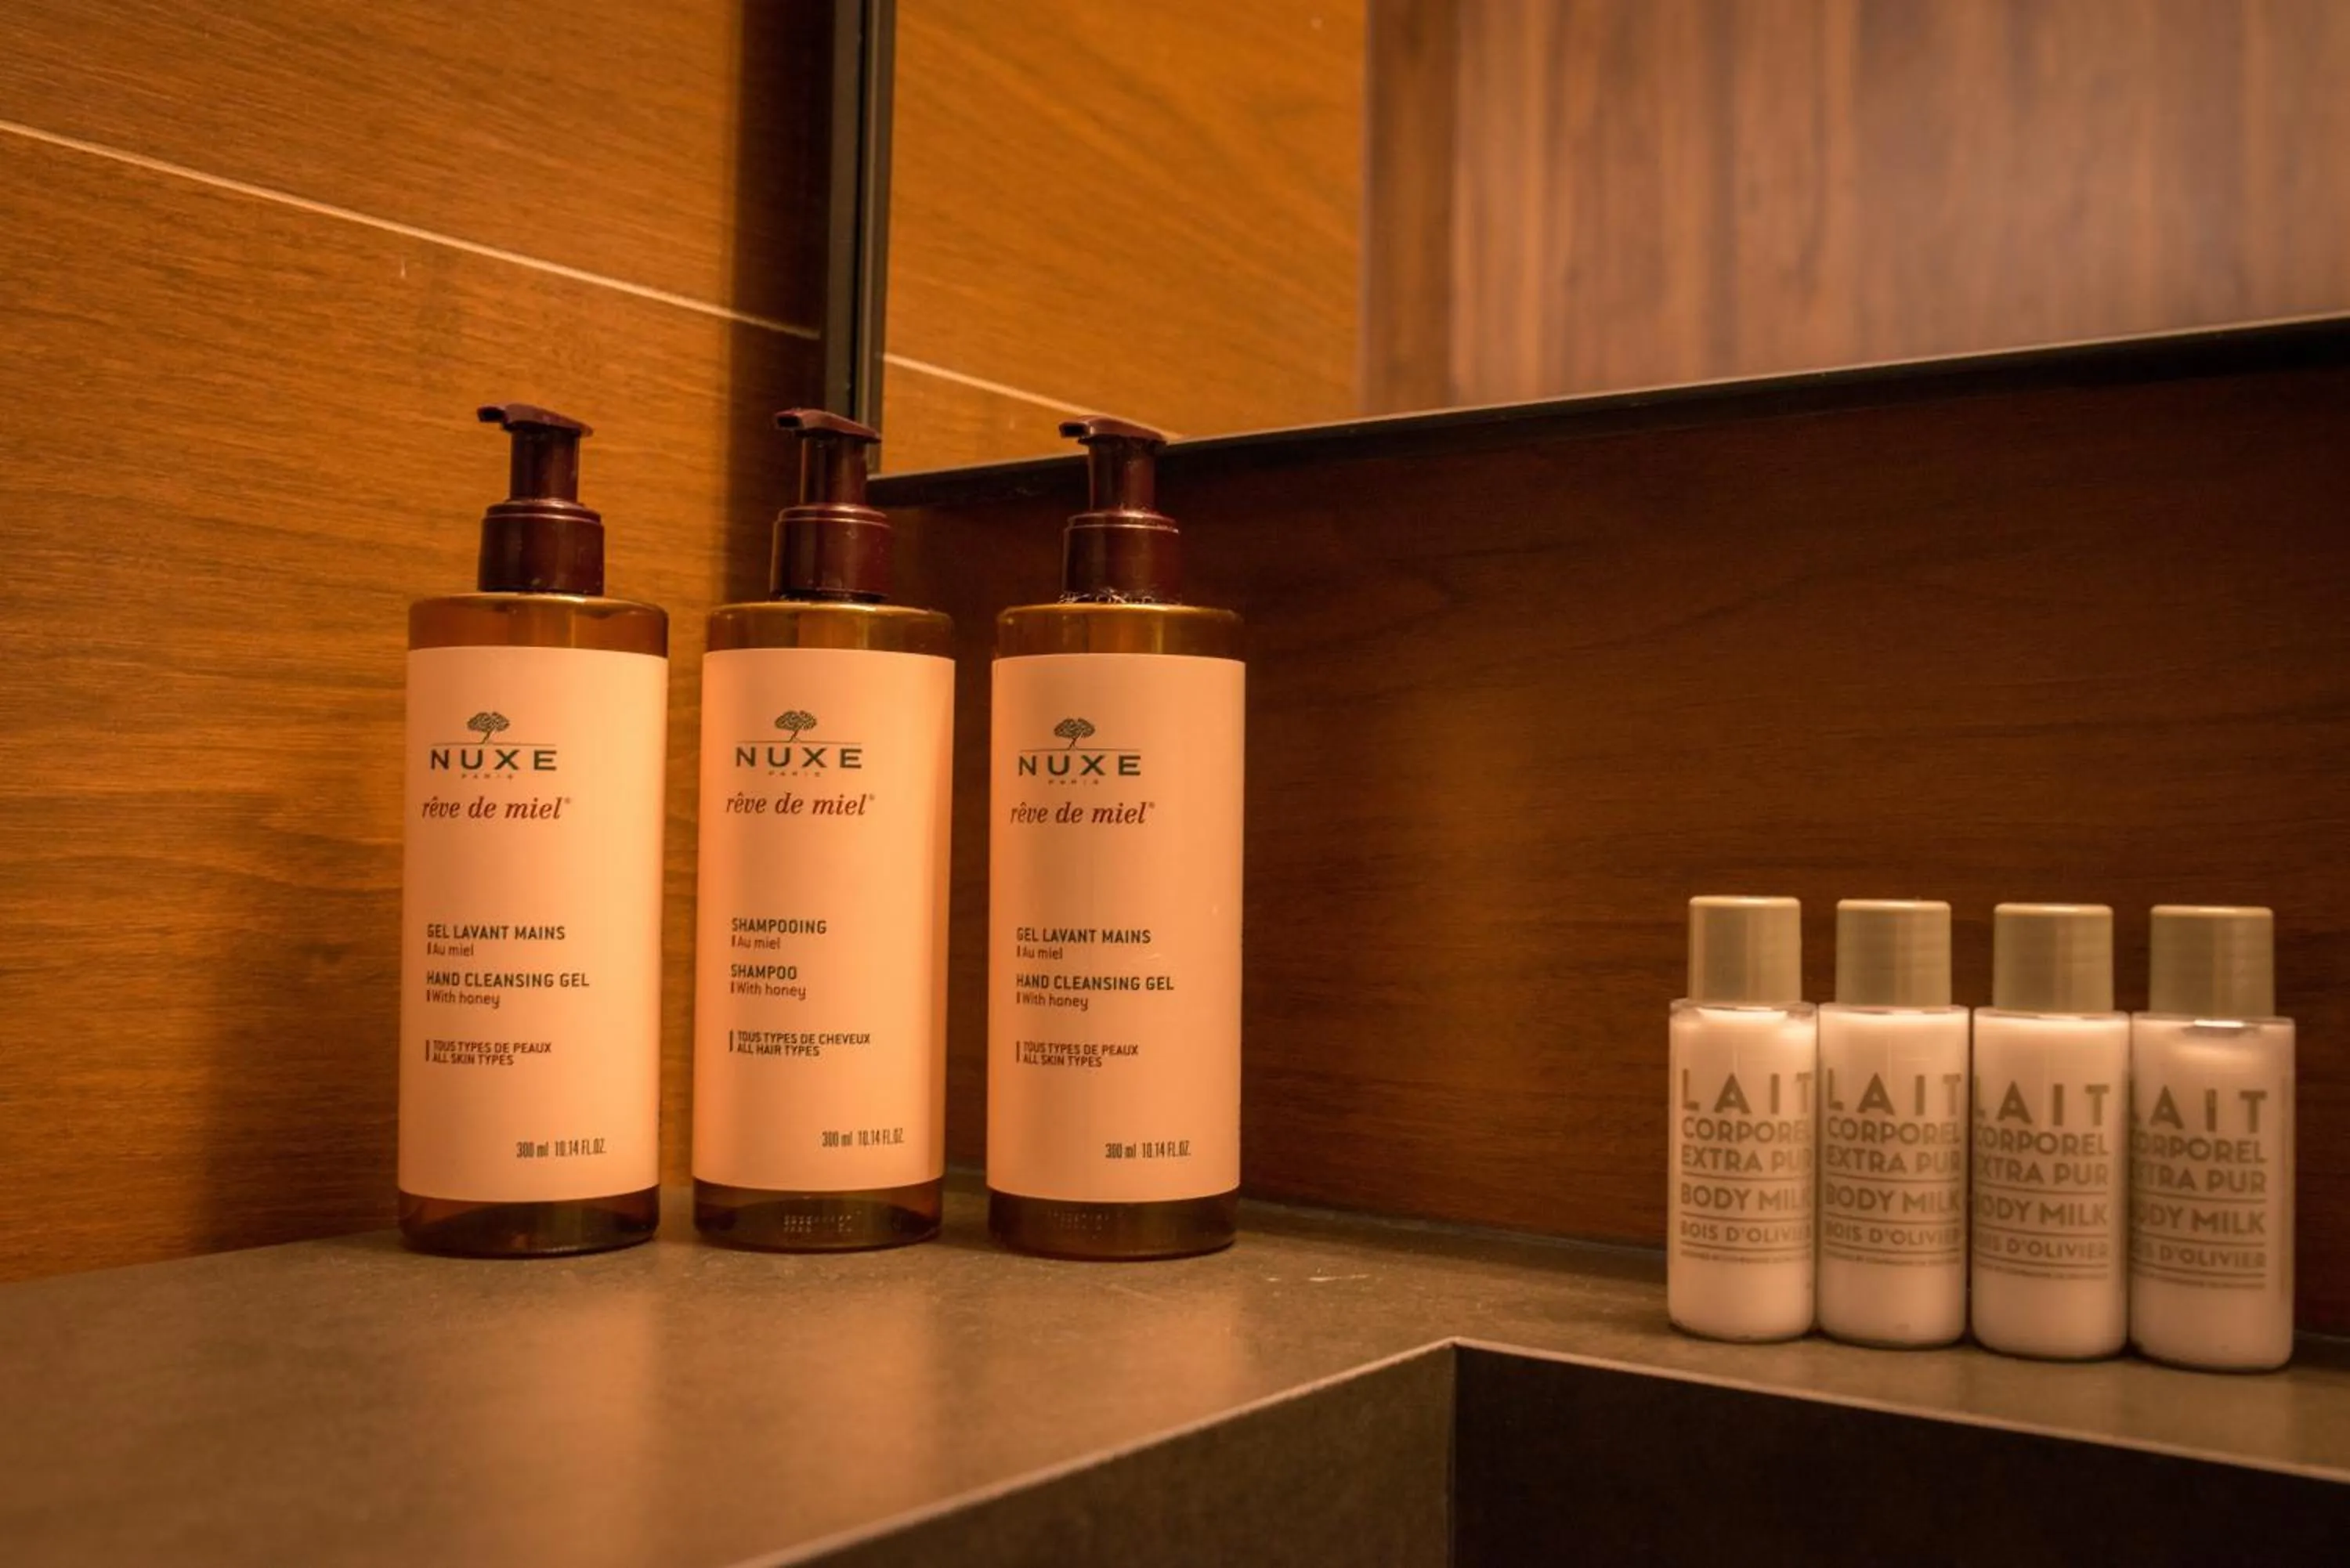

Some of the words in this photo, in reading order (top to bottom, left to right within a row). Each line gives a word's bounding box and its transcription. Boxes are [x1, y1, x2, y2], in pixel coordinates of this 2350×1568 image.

[430, 749, 557, 771] NUXE
[736, 747, 862, 769] NUXE
[1018, 755, 1141, 776] NUXE
[421, 796, 460, 818] rêve
[468, 796, 497, 818] de
[725, 792, 766, 814] rêve
[775, 792, 804, 814] de
[1010, 802, 1048, 824] rêve
[1055, 802, 1083, 824] de
[427, 923, 450, 938] GEL
[454, 925, 509, 940] LAVANT
[515, 926, 566, 940] MAINS
[732, 918, 826, 934] SHAMPOOING
[1017, 927, 1039, 941] GEL
[1043, 928, 1097, 943] LAVANT
[1101, 930, 1152, 944] MAINS
[433, 943, 446, 956] Au
[449, 943, 474, 956] miel
[738, 936, 750, 948] Au
[754, 937, 781, 949] miel
[1022, 946, 1035, 959] Au
[1038, 947, 1063, 959] miel
[427, 971, 460, 986] HAND
[465, 973, 554, 987] CLEANSING
[559, 974, 589, 987] GEL
[731, 964, 797, 980] SHAMPOO
[737, 982, 762, 995] With
[765, 983, 807, 1000] honey
[1017, 974, 1049, 988] HAND
[1054, 976, 1141, 991] CLEANSING
[1146, 977, 1175, 991] GEL
[432, 990, 456, 1004] With
[459, 990, 501, 1009] honey
[1022, 992, 1046, 1006] With
[1049, 992, 1089, 1011] honey
[433, 1039, 457, 1052] TOUS
[458, 1041, 491, 1053] TYPES
[494, 1042, 510, 1053] DE
[513, 1042, 551, 1053] PEAUX
[738, 1031, 762, 1043] TOUS
[765, 1032, 797, 1045] TYPES
[801, 1033, 815, 1045] DE
[819, 1033, 870, 1046] CHEVEUX
[432, 1053, 450, 1064] ALL
[451, 1053, 475, 1064] SKIN
[477, 1054, 514, 1065] TYPES
[737, 1044, 754, 1054] ALL
[757, 1045, 781, 1056] HAIR
[785, 1046, 819, 1057] TYPES
[1023, 1042, 1047, 1053] TOUS
[1048, 1043, 1080, 1055] TYPES
[1083, 1044, 1097, 1055] DE
[1101, 1045, 1138, 1056] PEAUX
[1023, 1055, 1038, 1064] ALL
[1040, 1056, 1065, 1066] SKIN
[1067, 1057, 1102, 1068] TYPES
[1681, 1068, 1813, 1115] LAIT
[1827, 1068, 1962, 1116] LAIT
[2134, 1085, 2269, 1134] AIT
[822, 1131, 839, 1147] 300
[841, 1131, 852, 1147] ml
[858, 1129, 880, 1146] 10.14
[1827, 1115, 1961, 1145] CORPOREL
[516, 1142, 534, 1158] 300
[537, 1141, 548, 1158] ml
[555, 1140, 579, 1157] 10.14
[1104, 1143, 1123, 1159] 300
[1125, 1143, 1137, 1158] ml
[1681, 1144, 1763, 1172] EXTRA
[2135, 1132, 2269, 1164] ORPOREL
[1826, 1144, 1907, 1174] EXTRA
[1915, 1150, 1961, 1174] PUR
[2053, 1162, 2109, 1186] PUR
[2206, 1169, 2266, 1194] PUR
[1680, 1183, 1752, 1212] BODY
[1825, 1182, 1896, 1212] BODY
[1902, 1188, 1961, 1214] MILK
[1976, 1192, 2032, 1223] ODY
[2039, 1201, 2108, 1227] MILK
[1680, 1220, 1719, 1241] BOIS
[2191, 1208, 2266, 1235] MILK
[2160, 1245, 2266, 1268] D'OLIVIER
